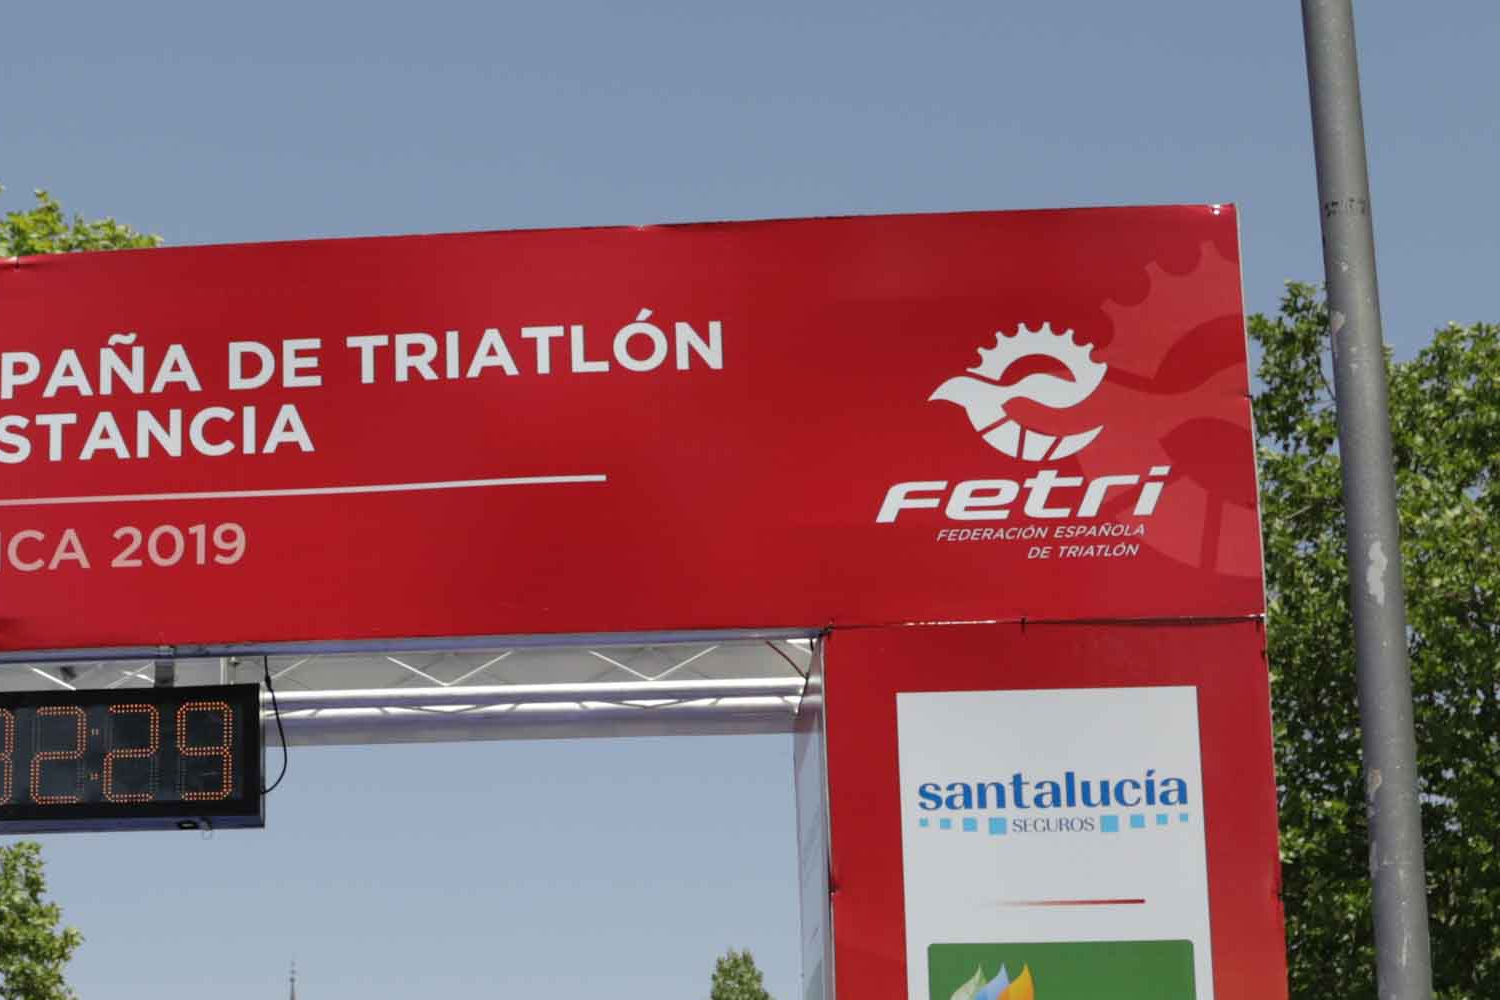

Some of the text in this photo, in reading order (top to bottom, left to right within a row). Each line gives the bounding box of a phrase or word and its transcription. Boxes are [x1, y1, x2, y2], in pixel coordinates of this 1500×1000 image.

[228, 338, 322, 391] DE
[346, 308, 724, 383] TRIATLÓN
[111, 522, 247, 569] 2019
[936, 521, 1146, 543] FEDERACIÓN ESPAÑOLA
[1027, 542, 1140, 560] DE TRIATLÓN
[917, 769, 1189, 812] santalucía
[1011, 816, 1095, 834] SEGUROS
